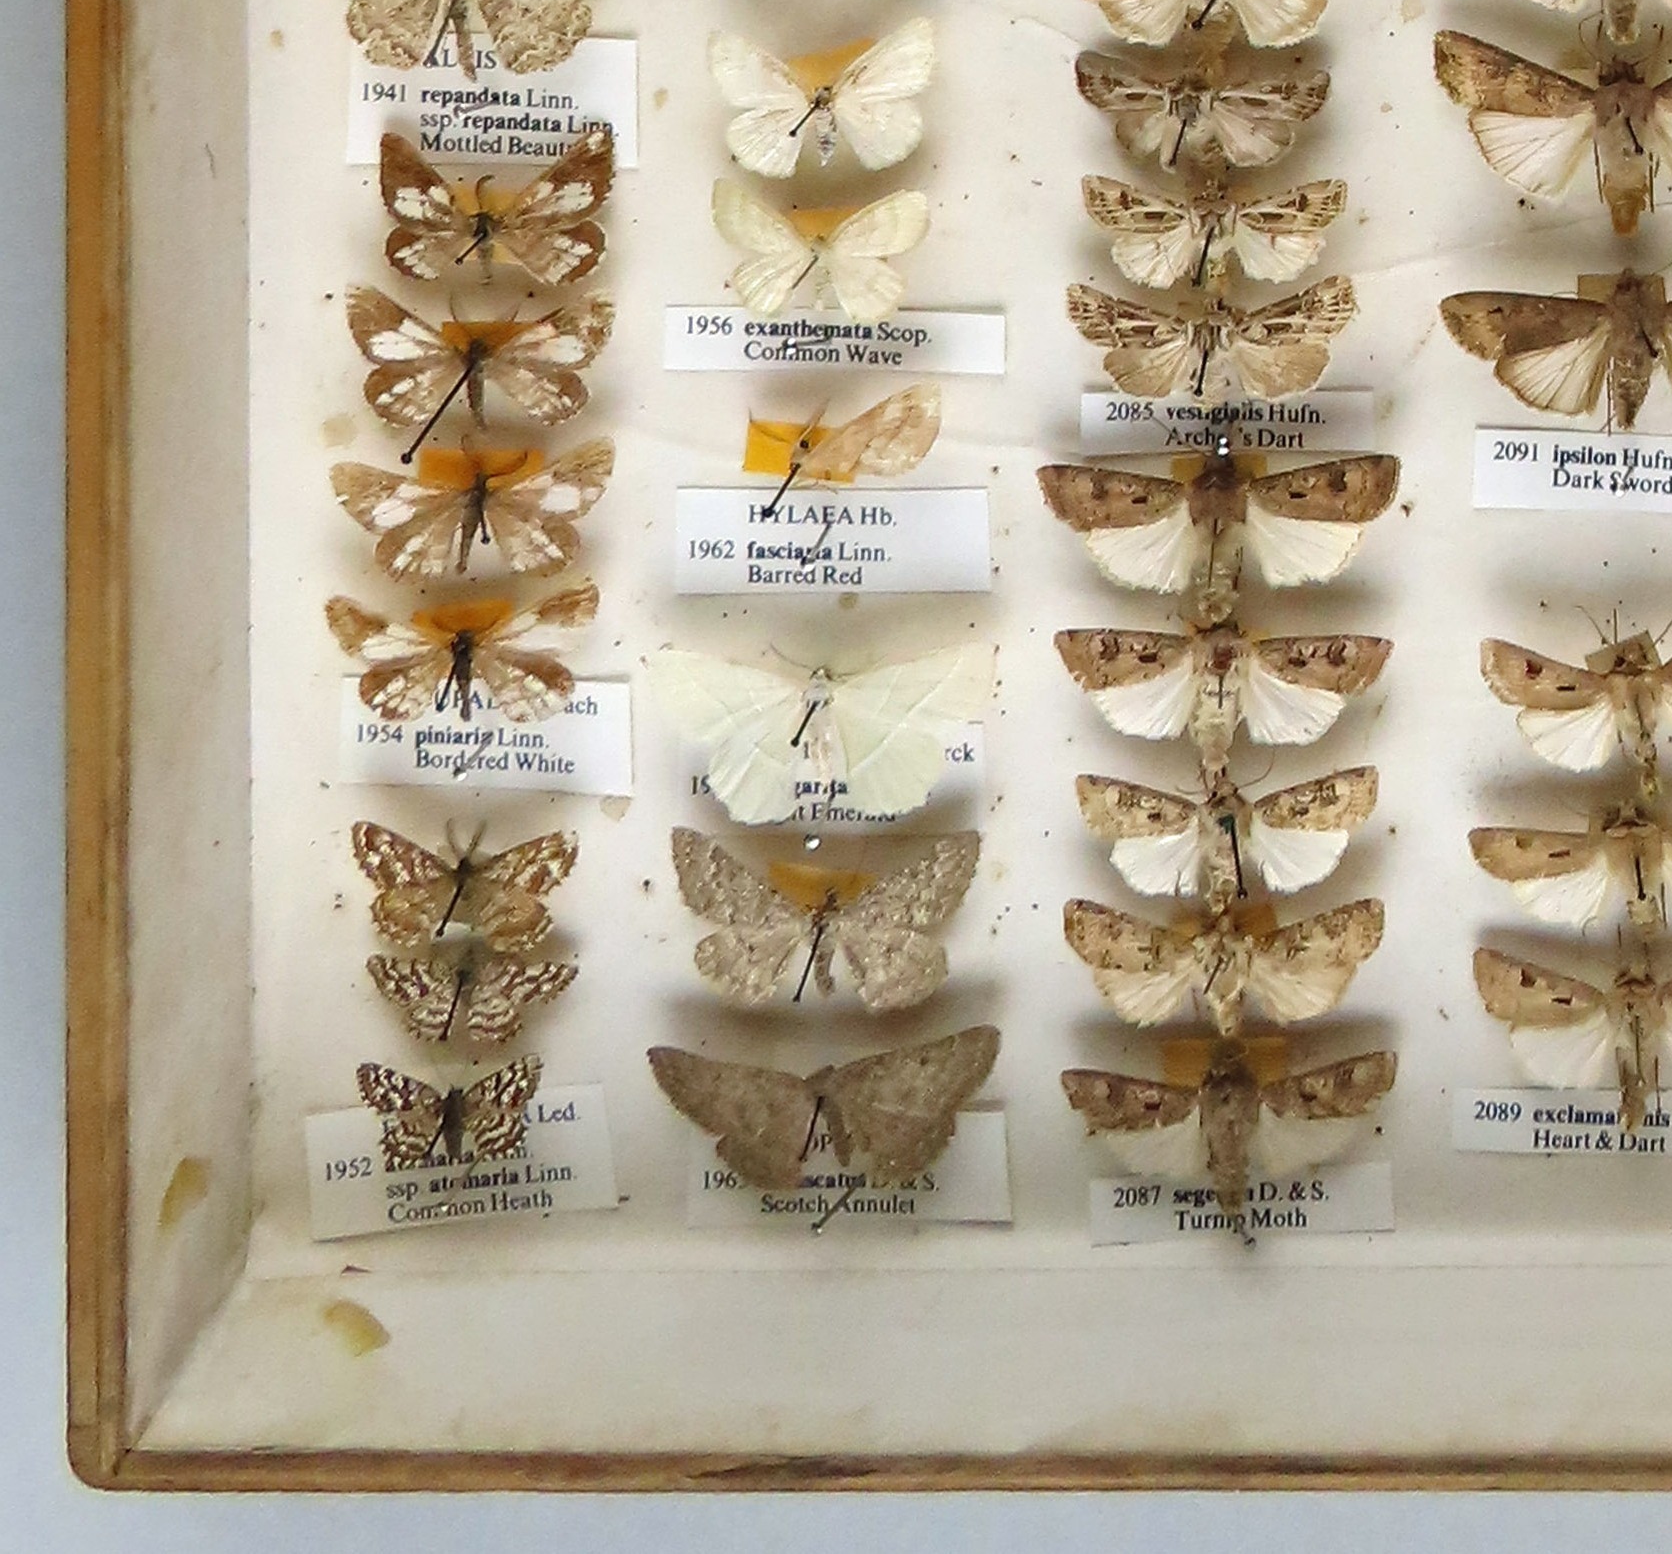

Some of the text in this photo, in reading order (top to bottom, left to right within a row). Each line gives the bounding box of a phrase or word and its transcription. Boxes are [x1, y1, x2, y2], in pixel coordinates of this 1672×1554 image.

[362, 84, 579, 109] 1941 repandata Linn.
[463, 114, 562, 133] repandata
[421, 133, 502, 154] Mottled
[686, 317, 932, 344] 1956 exanthemata Scop.
[847, 346, 902, 365] Wave
[1106, 402, 1325, 424] 2085 Hufn.
[1258, 429, 1303, 448] Dart
[1493, 443, 1539, 462] 2091
[1553, 446, 1616, 470] ipsilon
[1553, 467, 1604, 489] Dark
[860, 506, 897, 526] Hb.
[689, 541, 891, 561] 1962 Linn.
[748, 567, 863, 585] Barred Red
[357, 725, 403, 742] 1954
[498, 729, 549, 748] Linn.
[516, 753, 574, 773] White
[1475, 1102, 1521, 1121] 2089
[1534, 1130, 1665, 1152] Heart & Dart
[325, 1161, 372, 1180] 1952
[492, 1193, 552, 1211] Heath
[1114, 1181, 1328, 1207] 2087 D. & S.
[761, 1195, 829, 1214] Scotch
[1252, 1208, 1307, 1228] Moth
